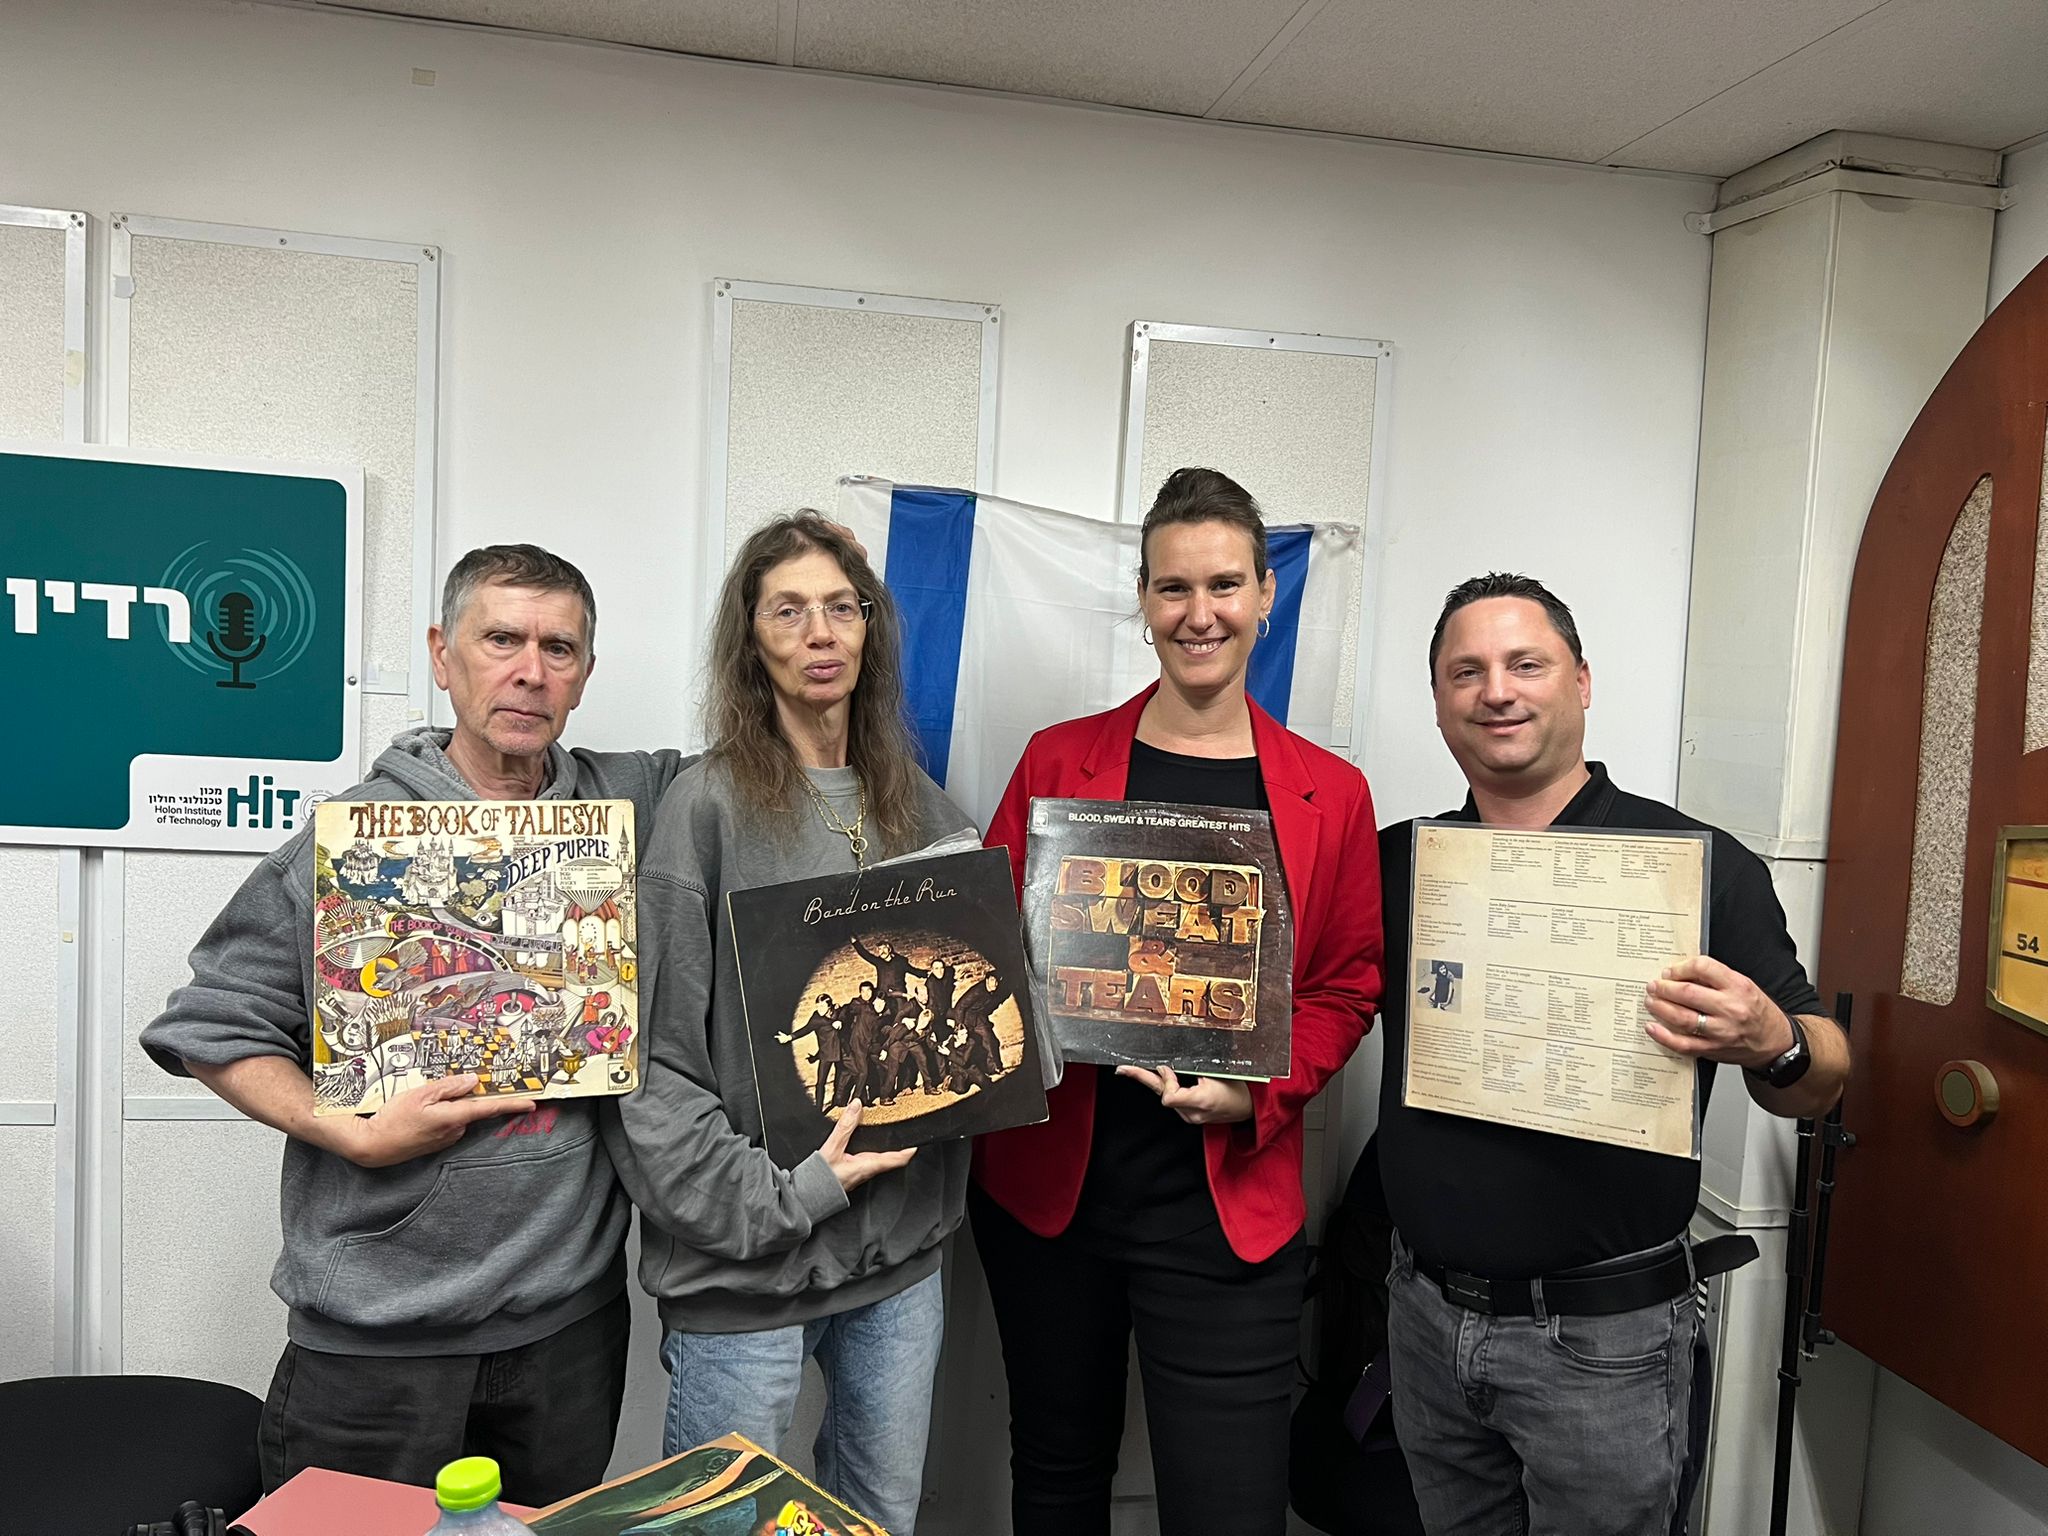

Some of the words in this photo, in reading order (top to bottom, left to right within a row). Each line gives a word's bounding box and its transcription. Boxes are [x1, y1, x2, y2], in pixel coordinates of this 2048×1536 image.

[6, 577, 191, 643] רדיו
[148, 794, 176, 804] חולון
[179, 796, 222, 805] טכנולוגי
[200, 787, 222, 796] מכון
[155, 805, 182, 814] Holon
[184, 806, 222, 816] Institute
[156, 815, 167, 824] of
[169, 815, 222, 828] Technology
[350, 803, 403, 839] THE
[406, 804, 479, 836] BOOK
[481, 808, 502, 831] OF
[504, 803, 613, 836] TALIESYN
[1068, 813, 1103, 824] BLOOD,
[1103, 814, 1136, 825] SWEAT
[1136, 816, 1144, 825] &
[1144, 817, 1177, 827] TEARS
[1178, 818, 1228, 831] GREATEST
[1229, 821, 1251, 832] HITS
[507, 847, 551, 890] DEEP
[554, 838, 610, 863] PURPLE
[1070, 859, 1249, 906] BLOOD
[803, 888, 860, 925] Band
[861, 902, 881, 912] on
[884, 880, 911, 907] the
[916, 877, 957, 902] Run
[1051, 897, 1260, 944] SWEAT
[1128, 939, 1176, 977] &
[2016, 933, 2039, 953] 54
[1056, 968, 1247, 1021] TEARS
